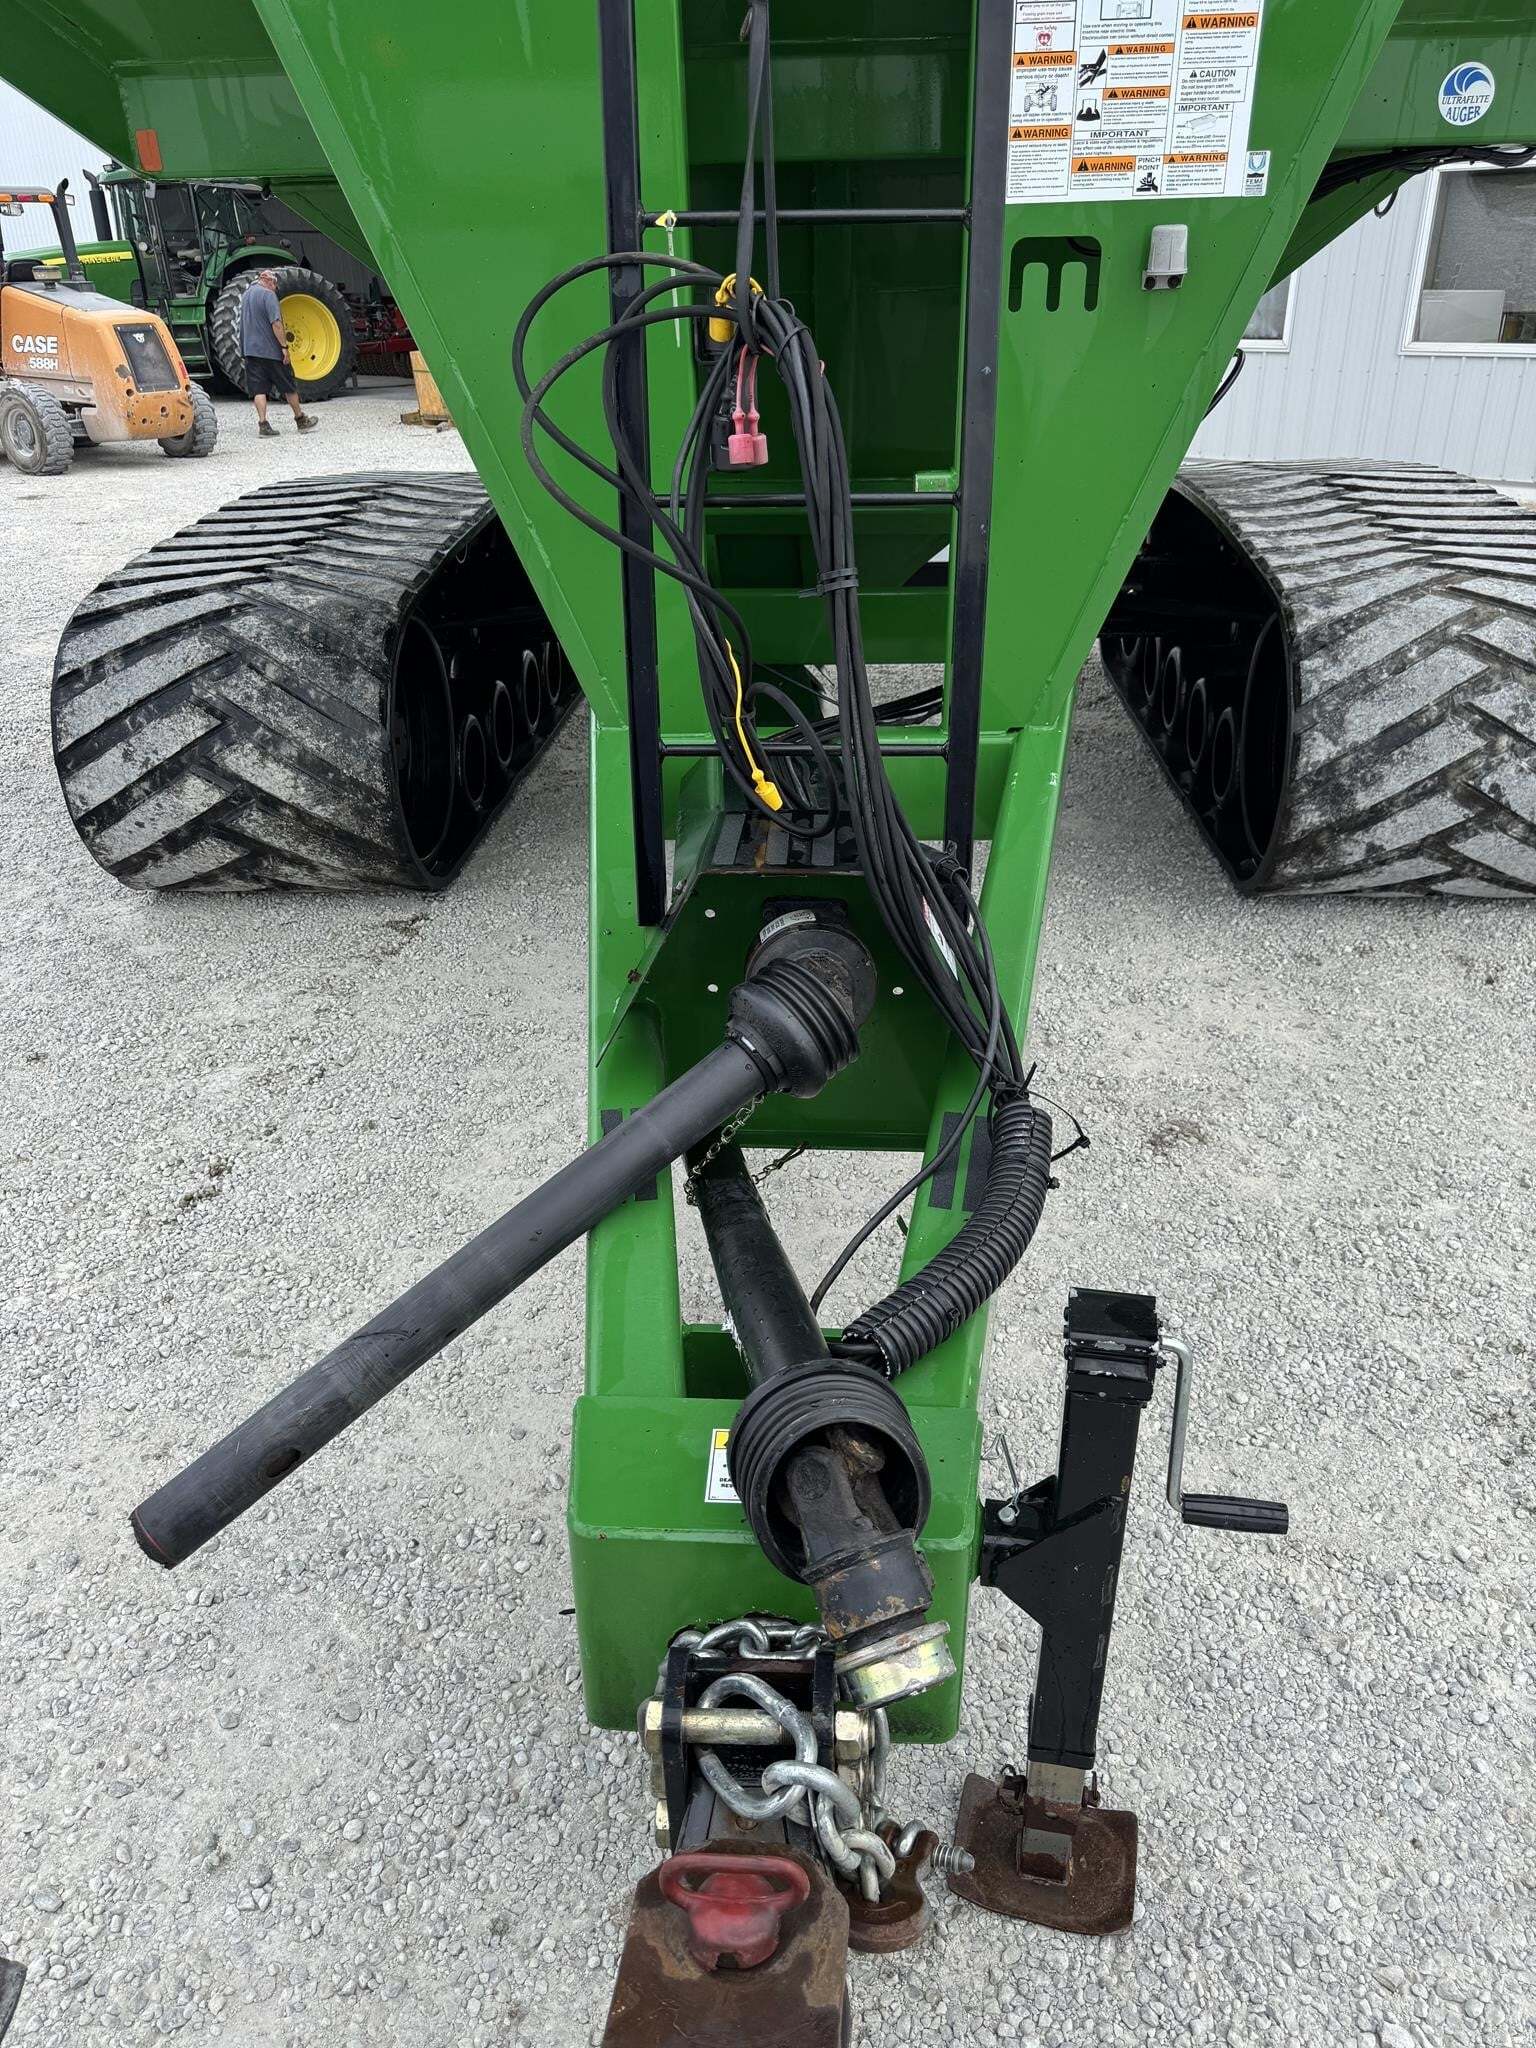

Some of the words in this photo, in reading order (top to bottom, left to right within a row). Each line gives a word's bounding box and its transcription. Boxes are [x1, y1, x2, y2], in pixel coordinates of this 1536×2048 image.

[1200, 16, 1255, 28] WARNING
[1125, 45, 1166, 54] WARNING
[1028, 54, 1073, 65] WARNING
[1199, 69, 1236, 78] CAUTION
[1121, 88, 1166, 98] WARNING
[1441, 94, 1491, 105] ULTRAFLYTE
[1178, 103, 1231, 112] IMPORTANT
[1446, 105, 1481, 122] AUGER
[1023, 128, 1069, 138] WARNING
[1090, 130, 1150, 138] IMPORTANT
[1180, 153, 1227, 162] WARNING
[1090, 161, 1134, 171] WARNING
[11, 334, 58, 354] CASE
[29, 357, 59, 371] 588H
